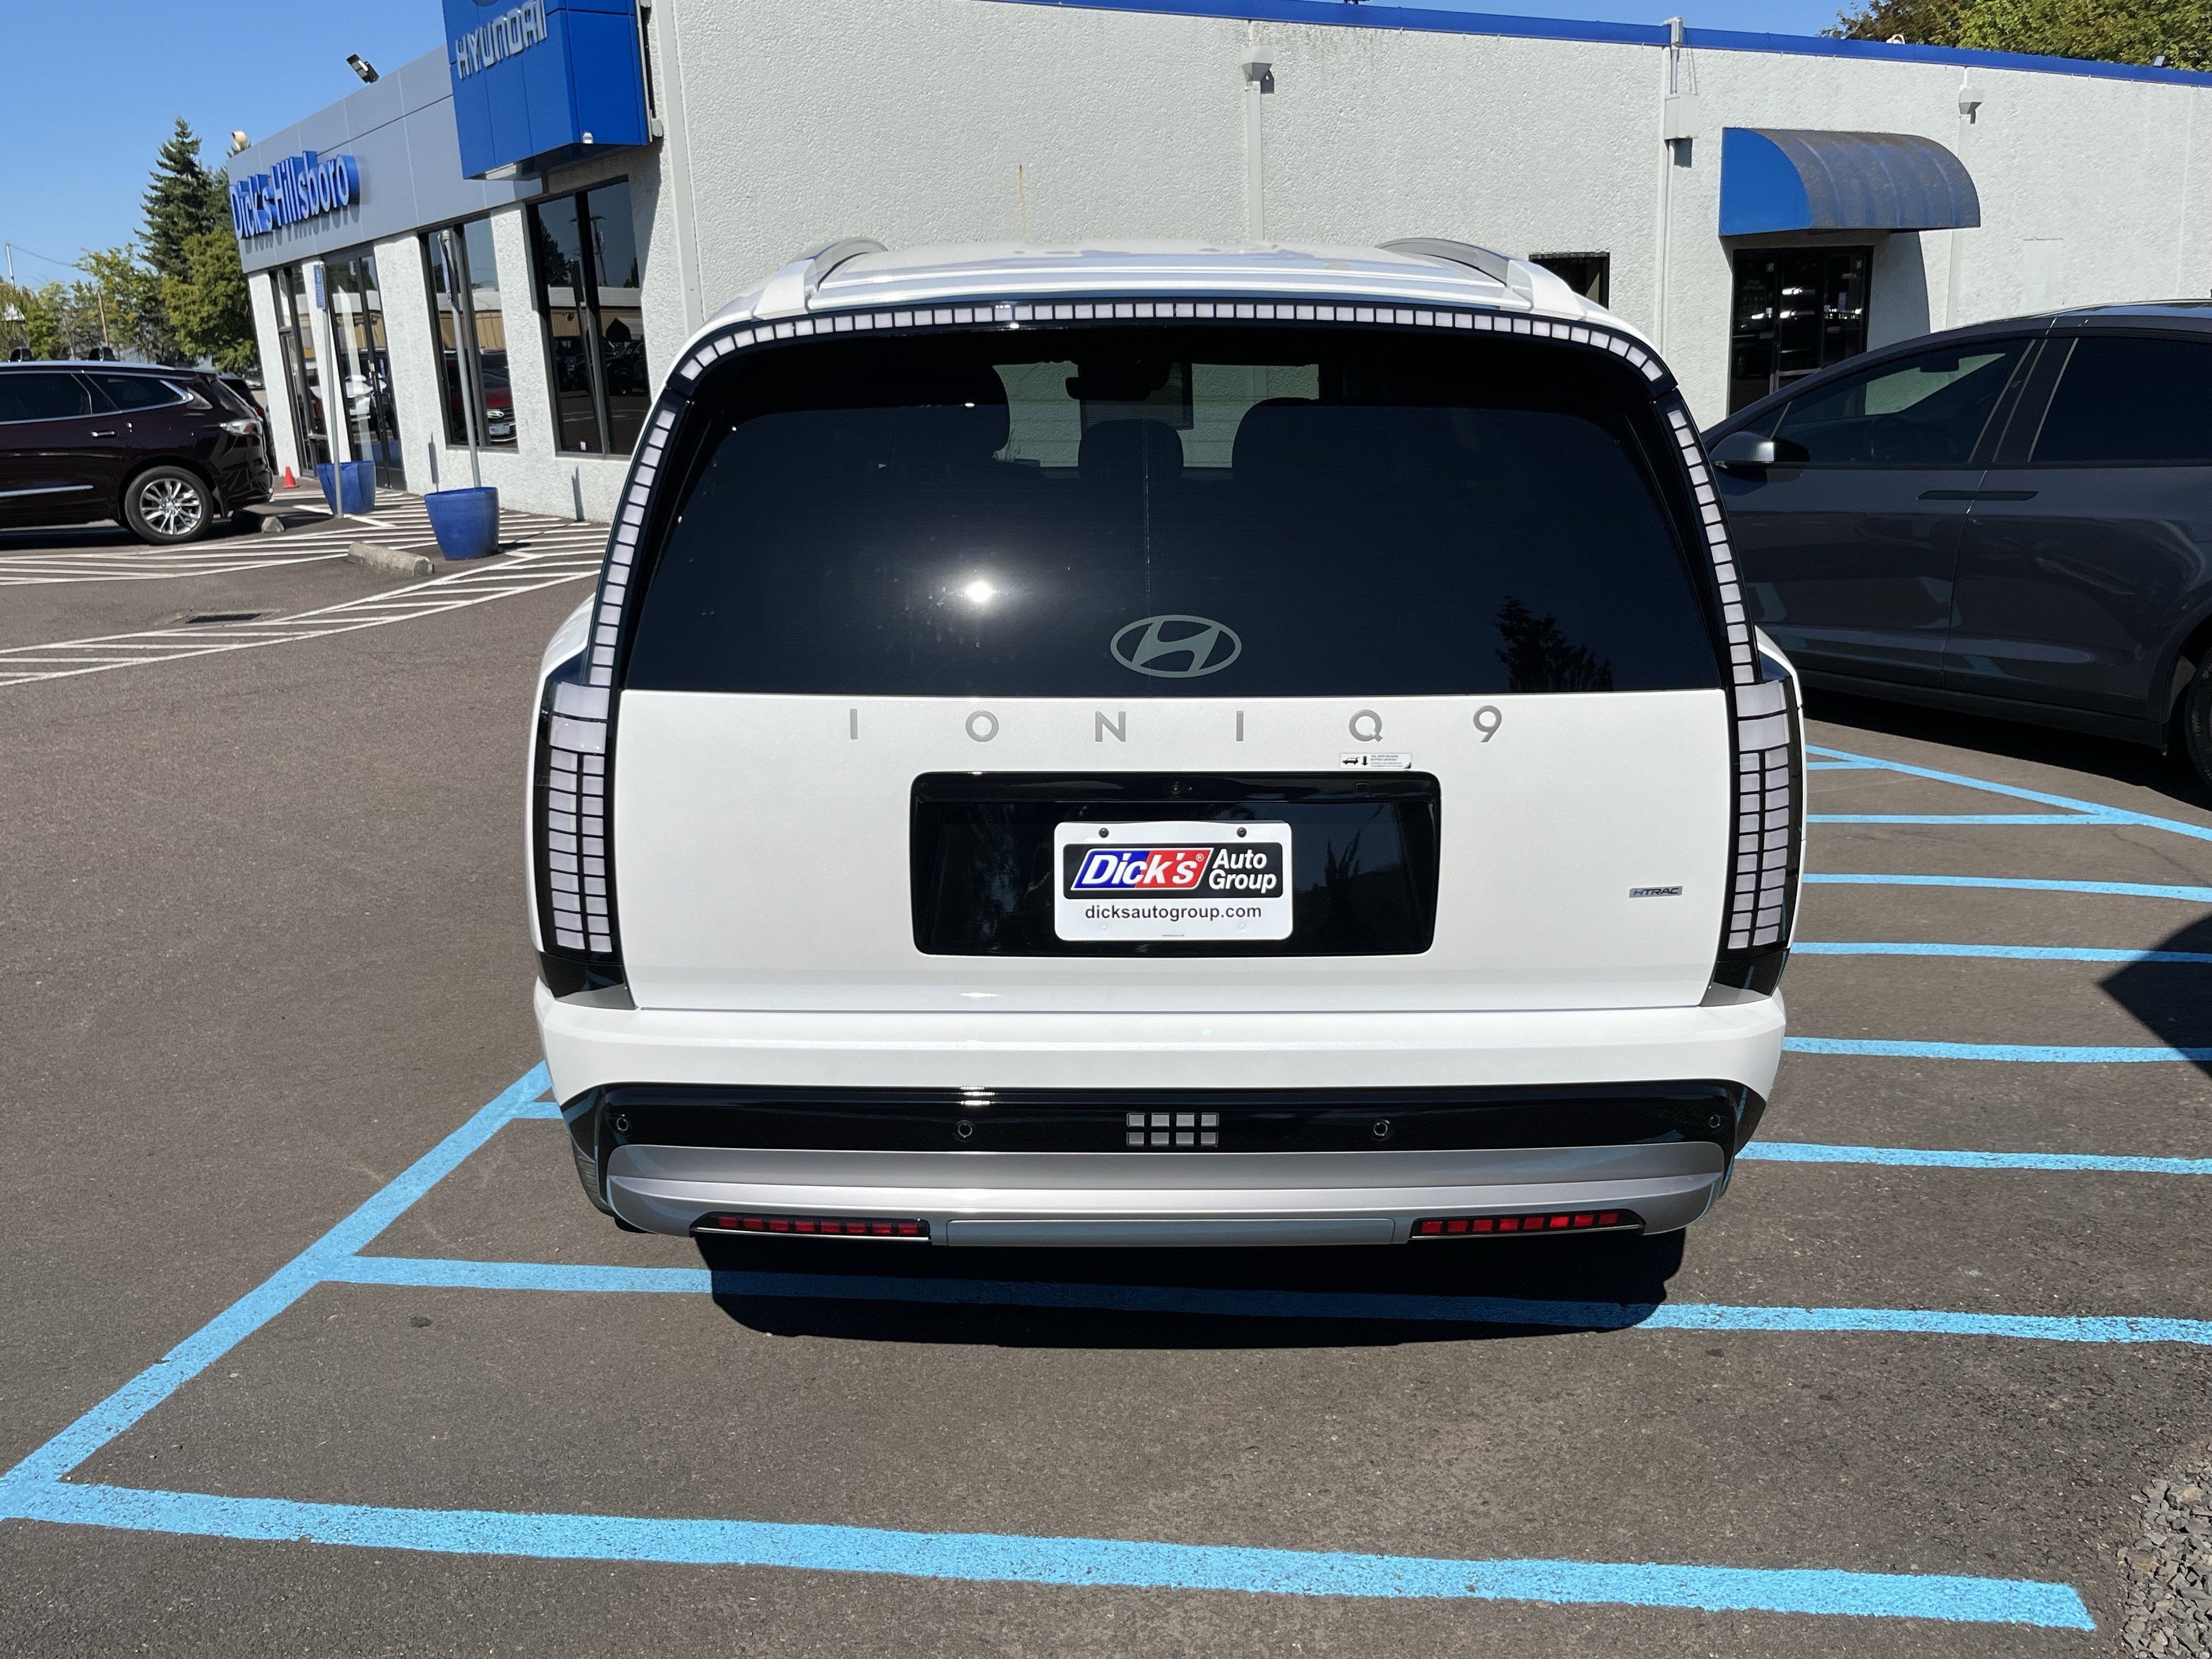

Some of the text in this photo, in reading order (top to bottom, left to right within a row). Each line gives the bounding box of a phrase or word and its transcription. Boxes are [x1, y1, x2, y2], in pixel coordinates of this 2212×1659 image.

[456, 0, 548, 80] HYUNDAI
[229, 151, 351, 240] Dick's Hillsboro
[850, 705, 1502, 743] IONIQ 9
[1212, 848, 1267, 870] Auto
[1209, 870, 1276, 894] Group
[1633, 887, 1679, 896] HTRAC
[1085, 905, 1262, 922] dicksautogroup.com
